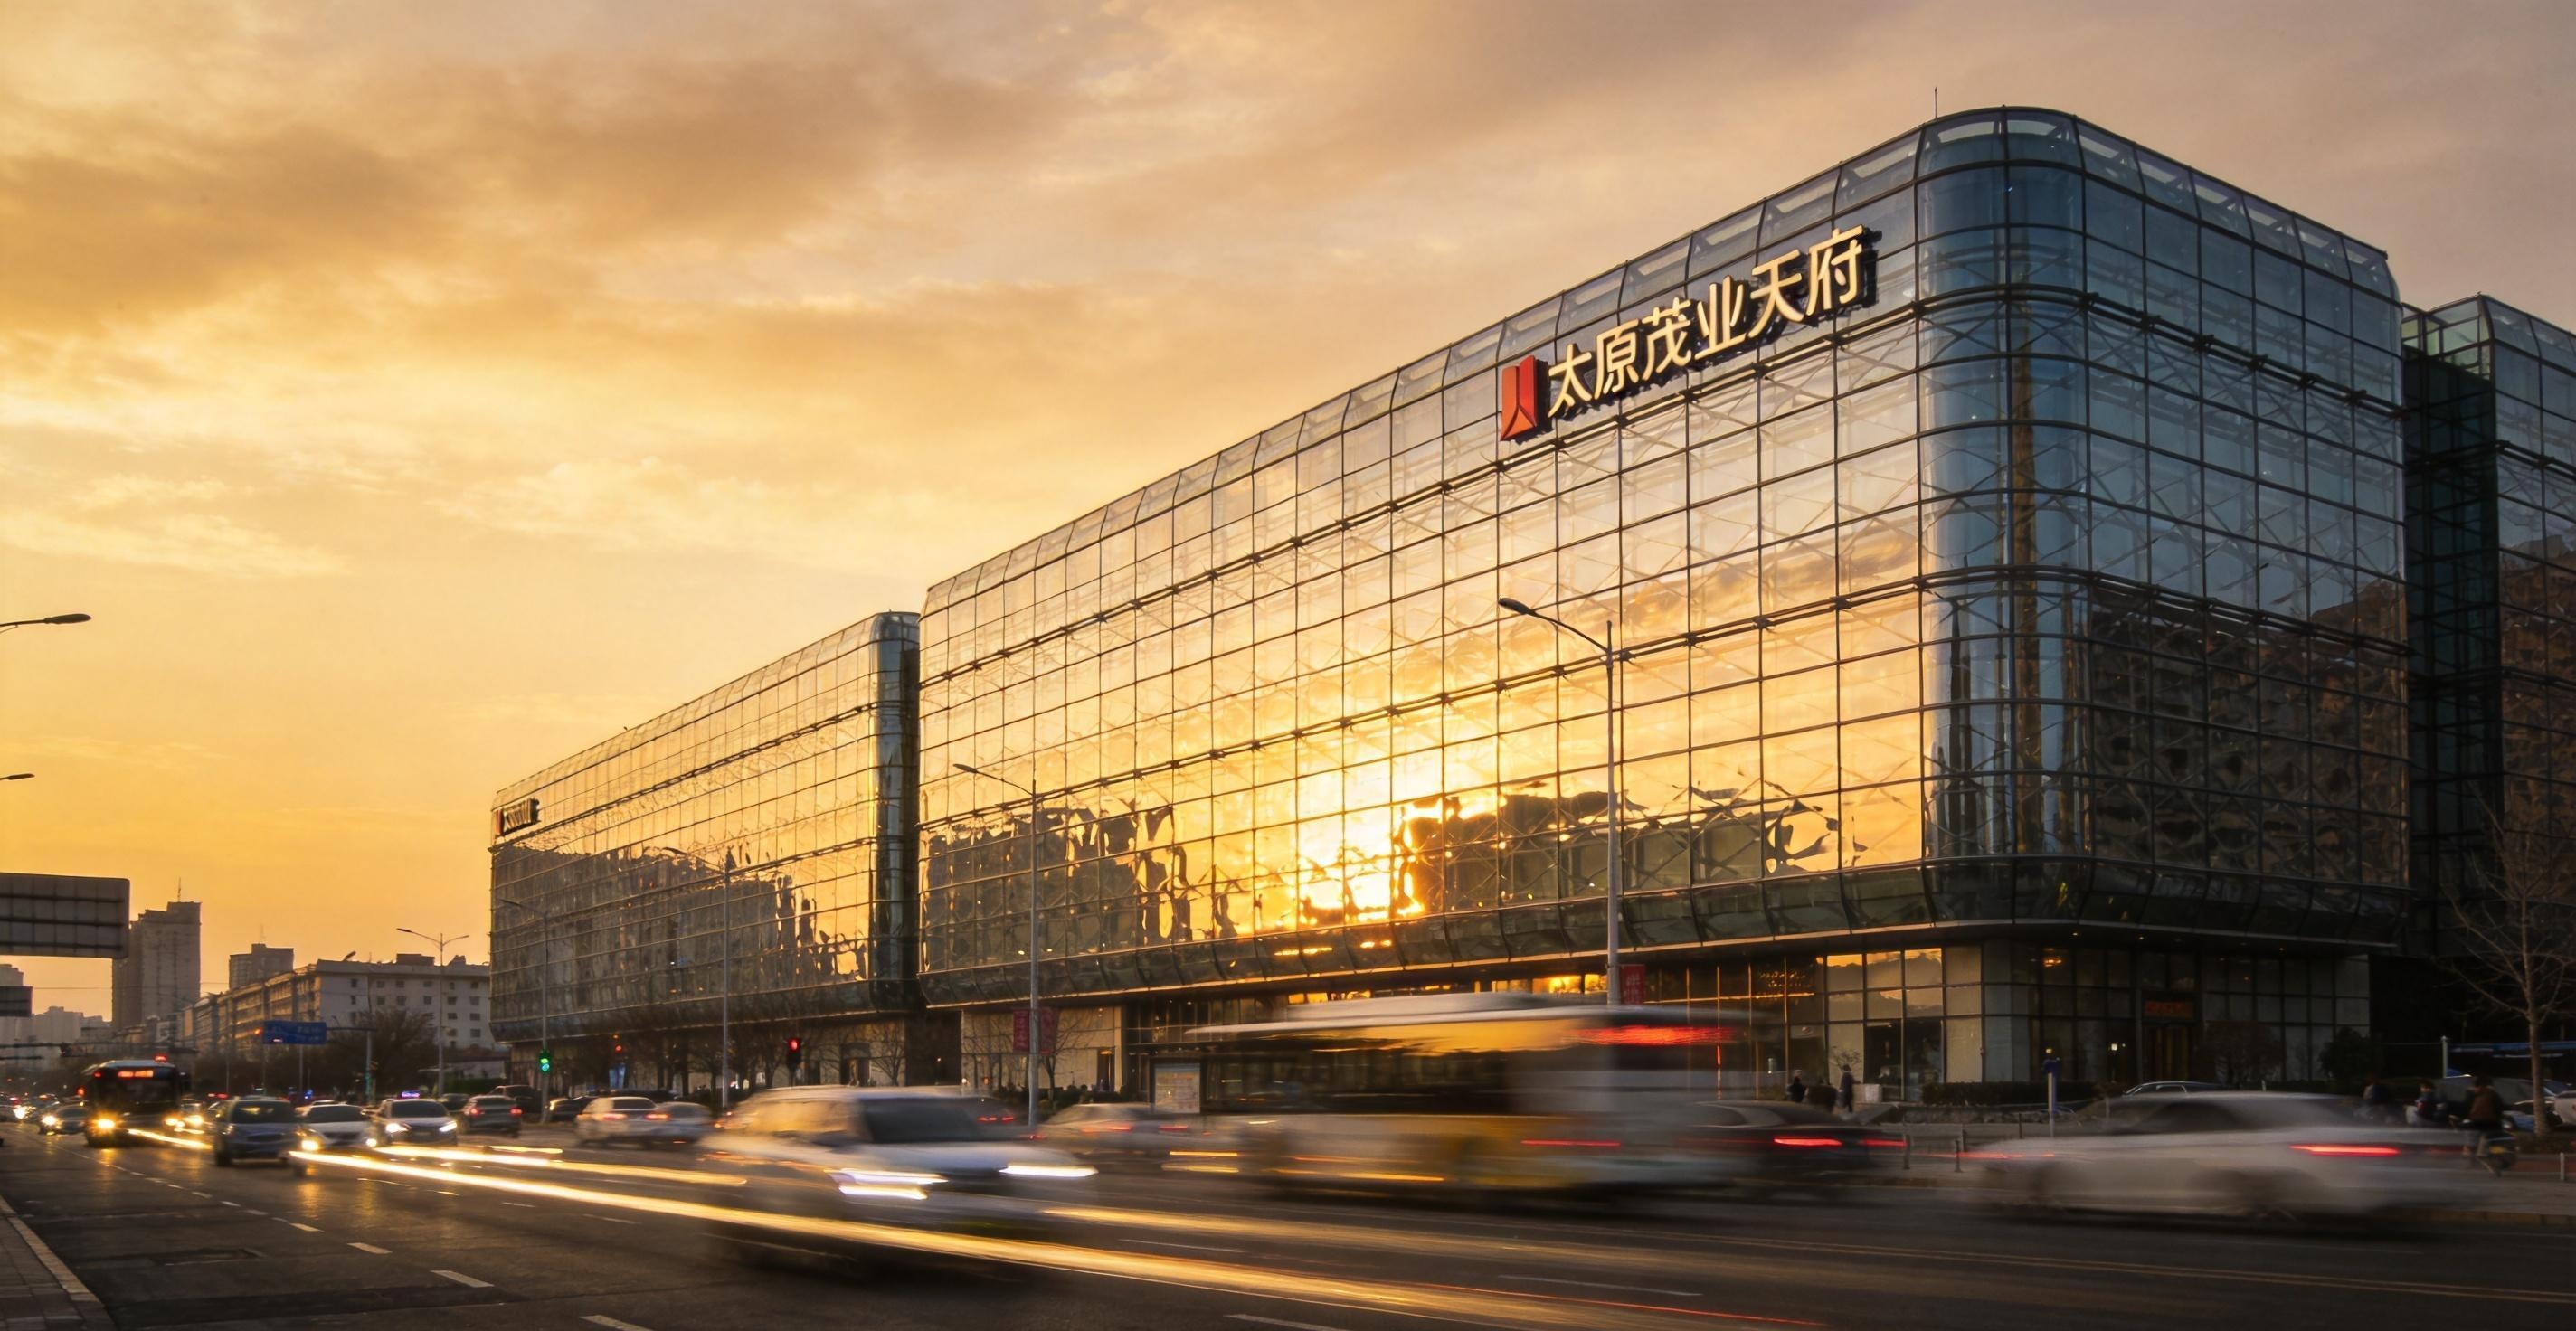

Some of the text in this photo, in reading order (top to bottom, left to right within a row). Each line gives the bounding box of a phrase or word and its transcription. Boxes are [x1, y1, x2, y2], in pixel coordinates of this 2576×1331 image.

[1548, 225, 1864, 418] 太原茂业天府
